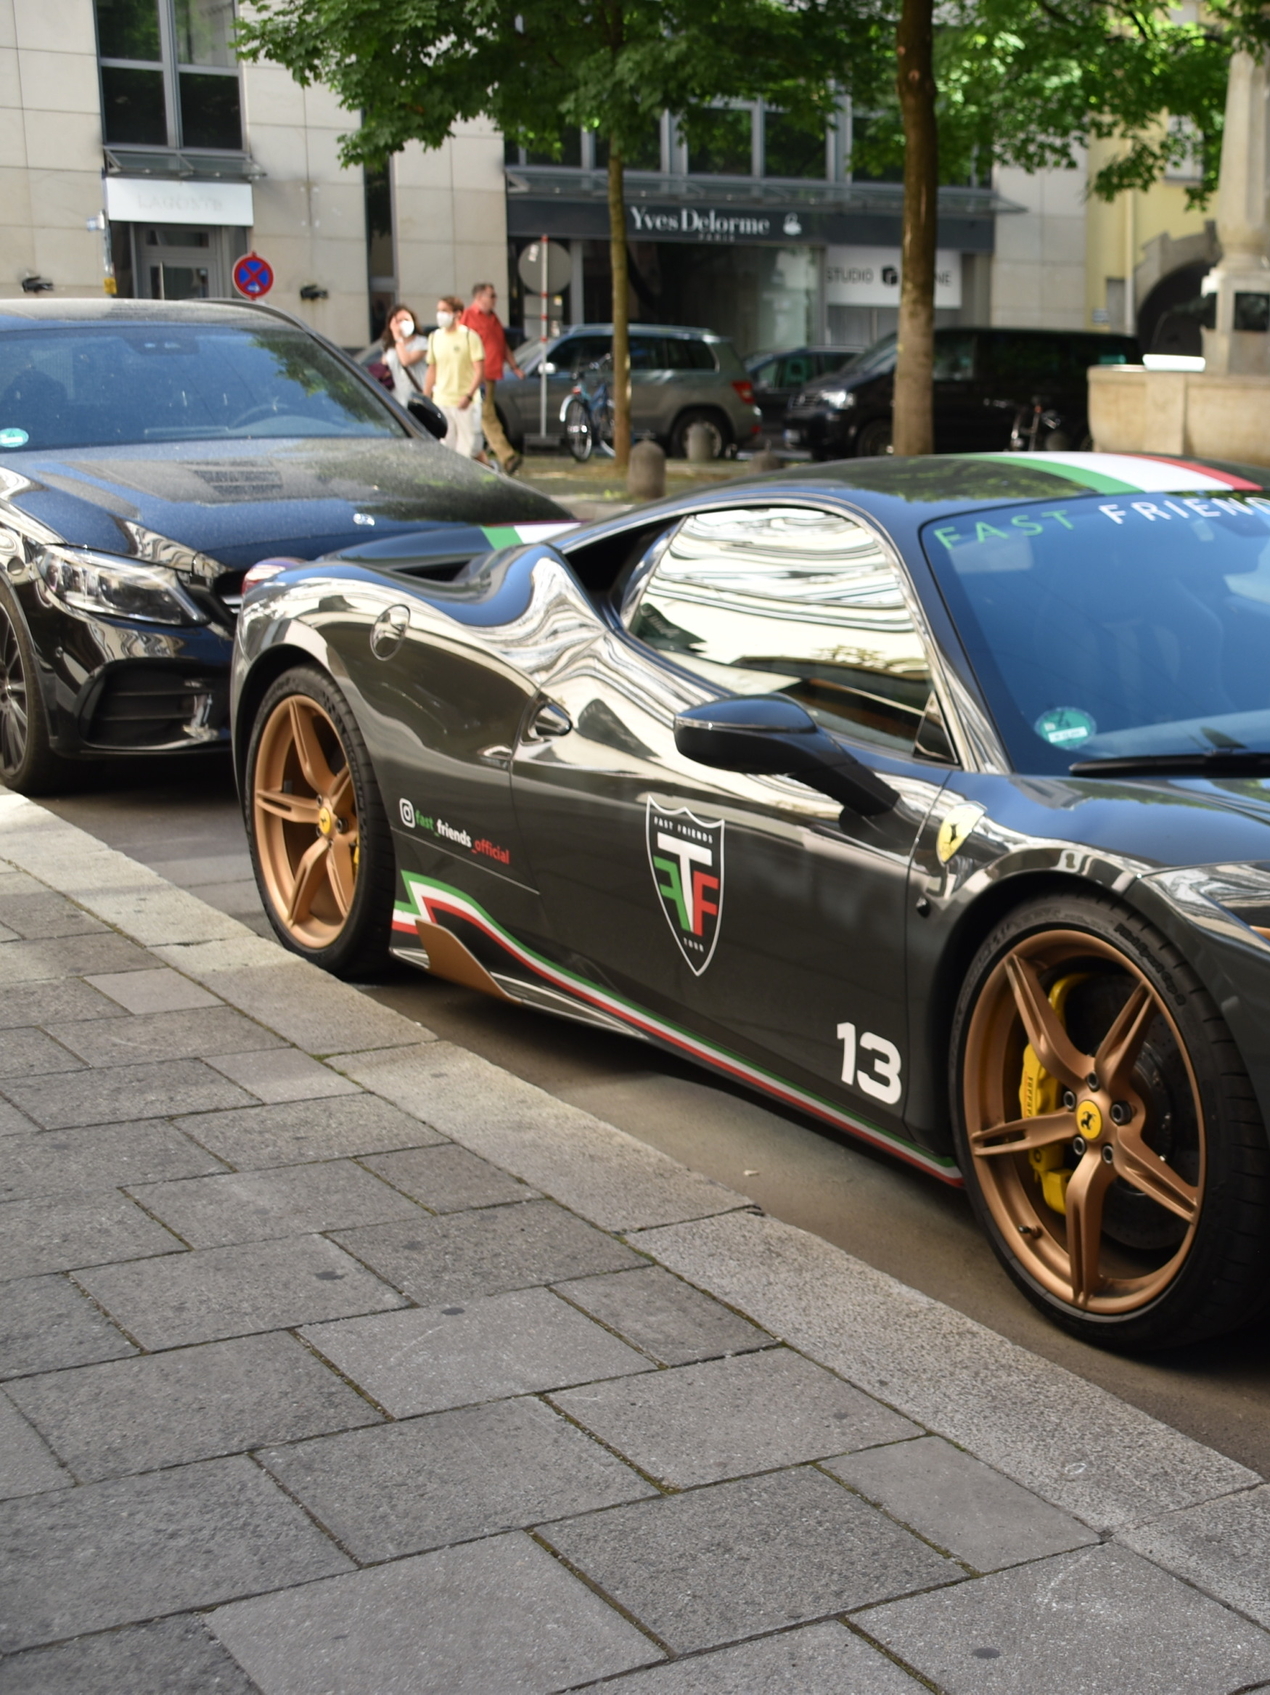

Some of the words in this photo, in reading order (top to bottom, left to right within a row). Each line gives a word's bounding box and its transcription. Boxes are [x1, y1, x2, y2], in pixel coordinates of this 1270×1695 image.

[630, 205, 679, 232] Yves
[681, 207, 771, 235] Delorme
[826, 266, 874, 285] STUDIO
[933, 509, 1075, 550] FAST
[654, 816, 673, 830] FAST
[677, 823, 713, 844] FRIENDS
[836, 1021, 902, 1105] 13
